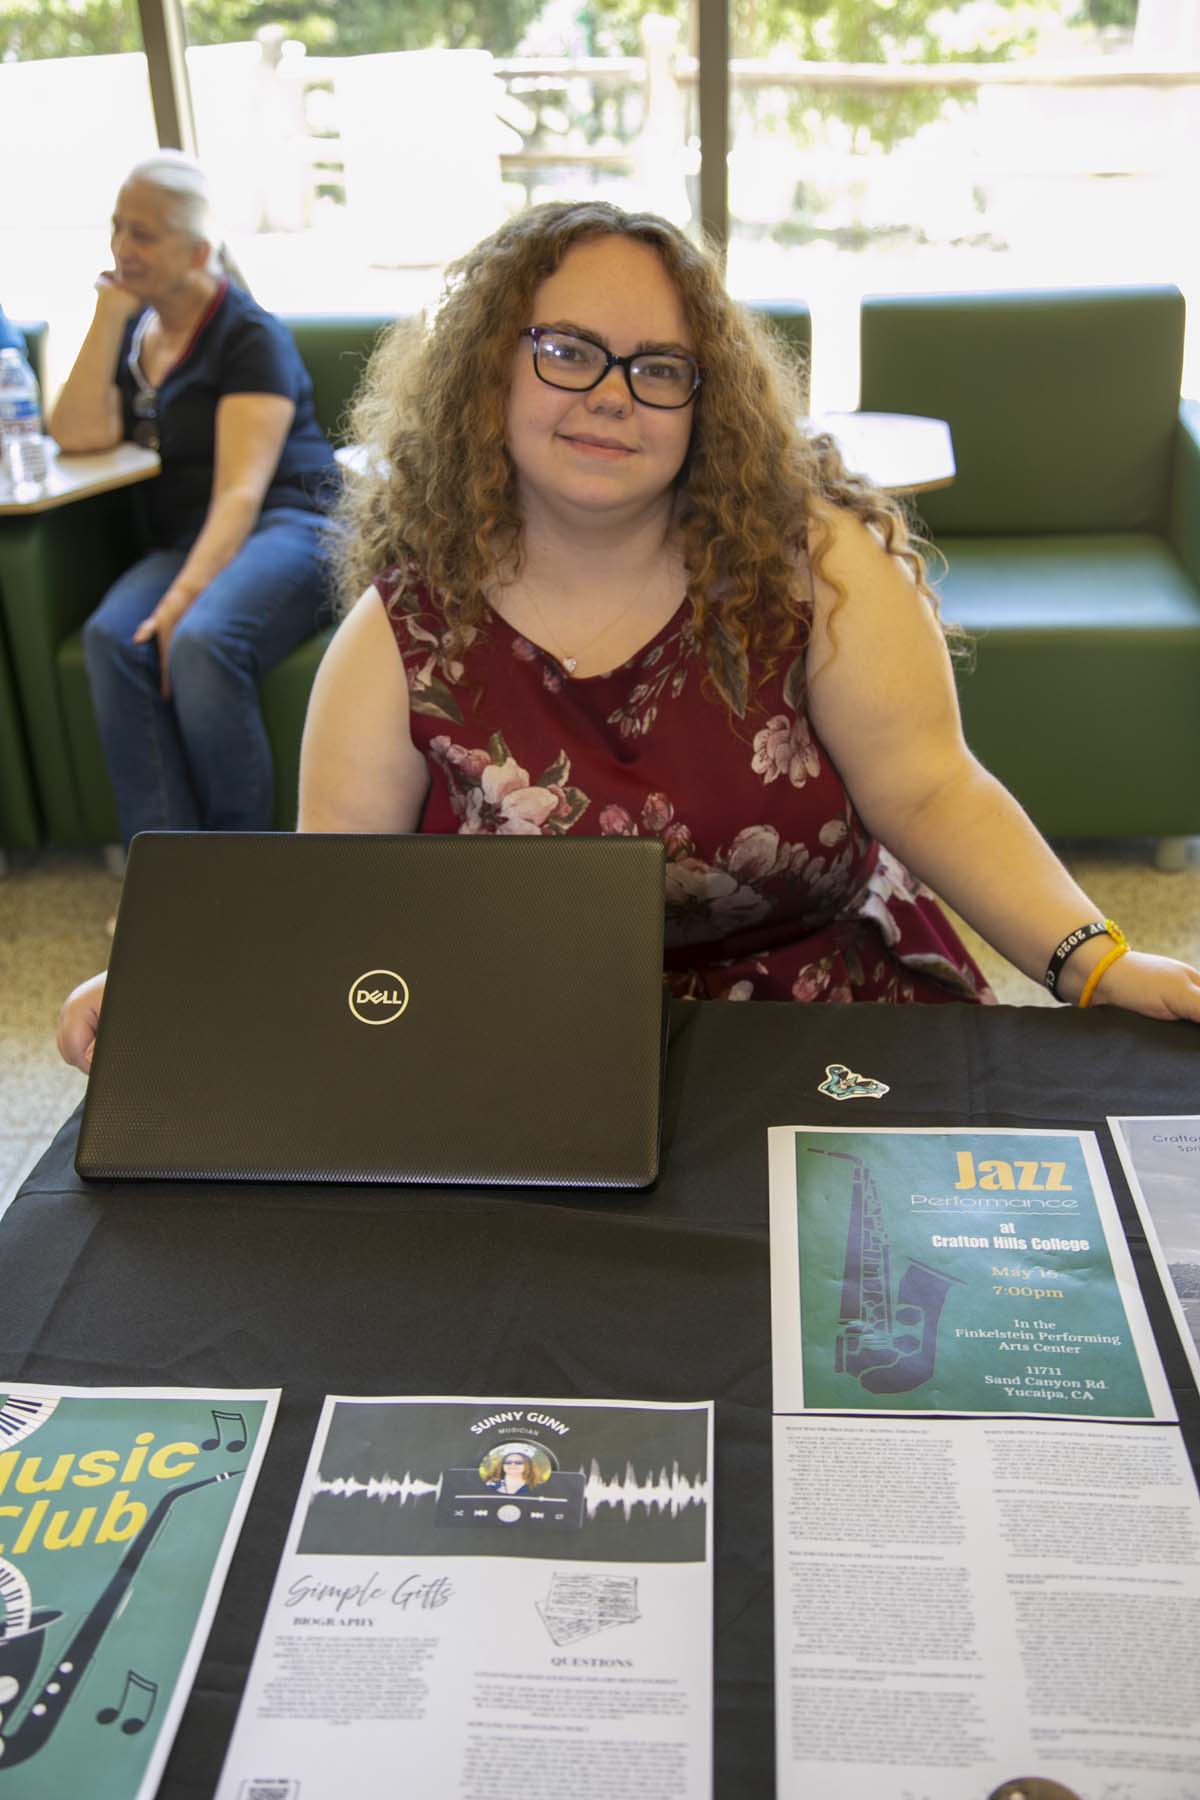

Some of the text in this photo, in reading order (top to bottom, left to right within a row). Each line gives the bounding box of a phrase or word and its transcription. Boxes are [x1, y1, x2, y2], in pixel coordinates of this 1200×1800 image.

[1056, 929, 1086, 959] 2025
[356, 989, 402, 1005] DELL
[1152, 1133, 1200, 1143] Crafto
[954, 1151, 1073, 1191] Jazz
[999, 1222, 1016, 1234] at
[932, 1235, 1090, 1252] Crafton Hills College
[991, 1265, 1031, 1280] May
[992, 1285, 1064, 1300] 7:00pm
[1014, 1319, 1056, 1330] In the
[954, 1328, 1122, 1346] Finkelstein Performing
[999, 1341, 1081, 1355] Arts Center
[1026, 1365, 1063, 1376] 11711
[984, 1375, 1021, 1386] Sand
[1025, 1377, 1081, 1389] Canyon
[1003, 1386, 1095, 1401] Yucaipa, CA
[470, 1411, 570, 1435] SUNNY GUNN
[284, 1571, 456, 1612] Simple Gifts
[551, 1656, 633, 1668] QUESTIONS
